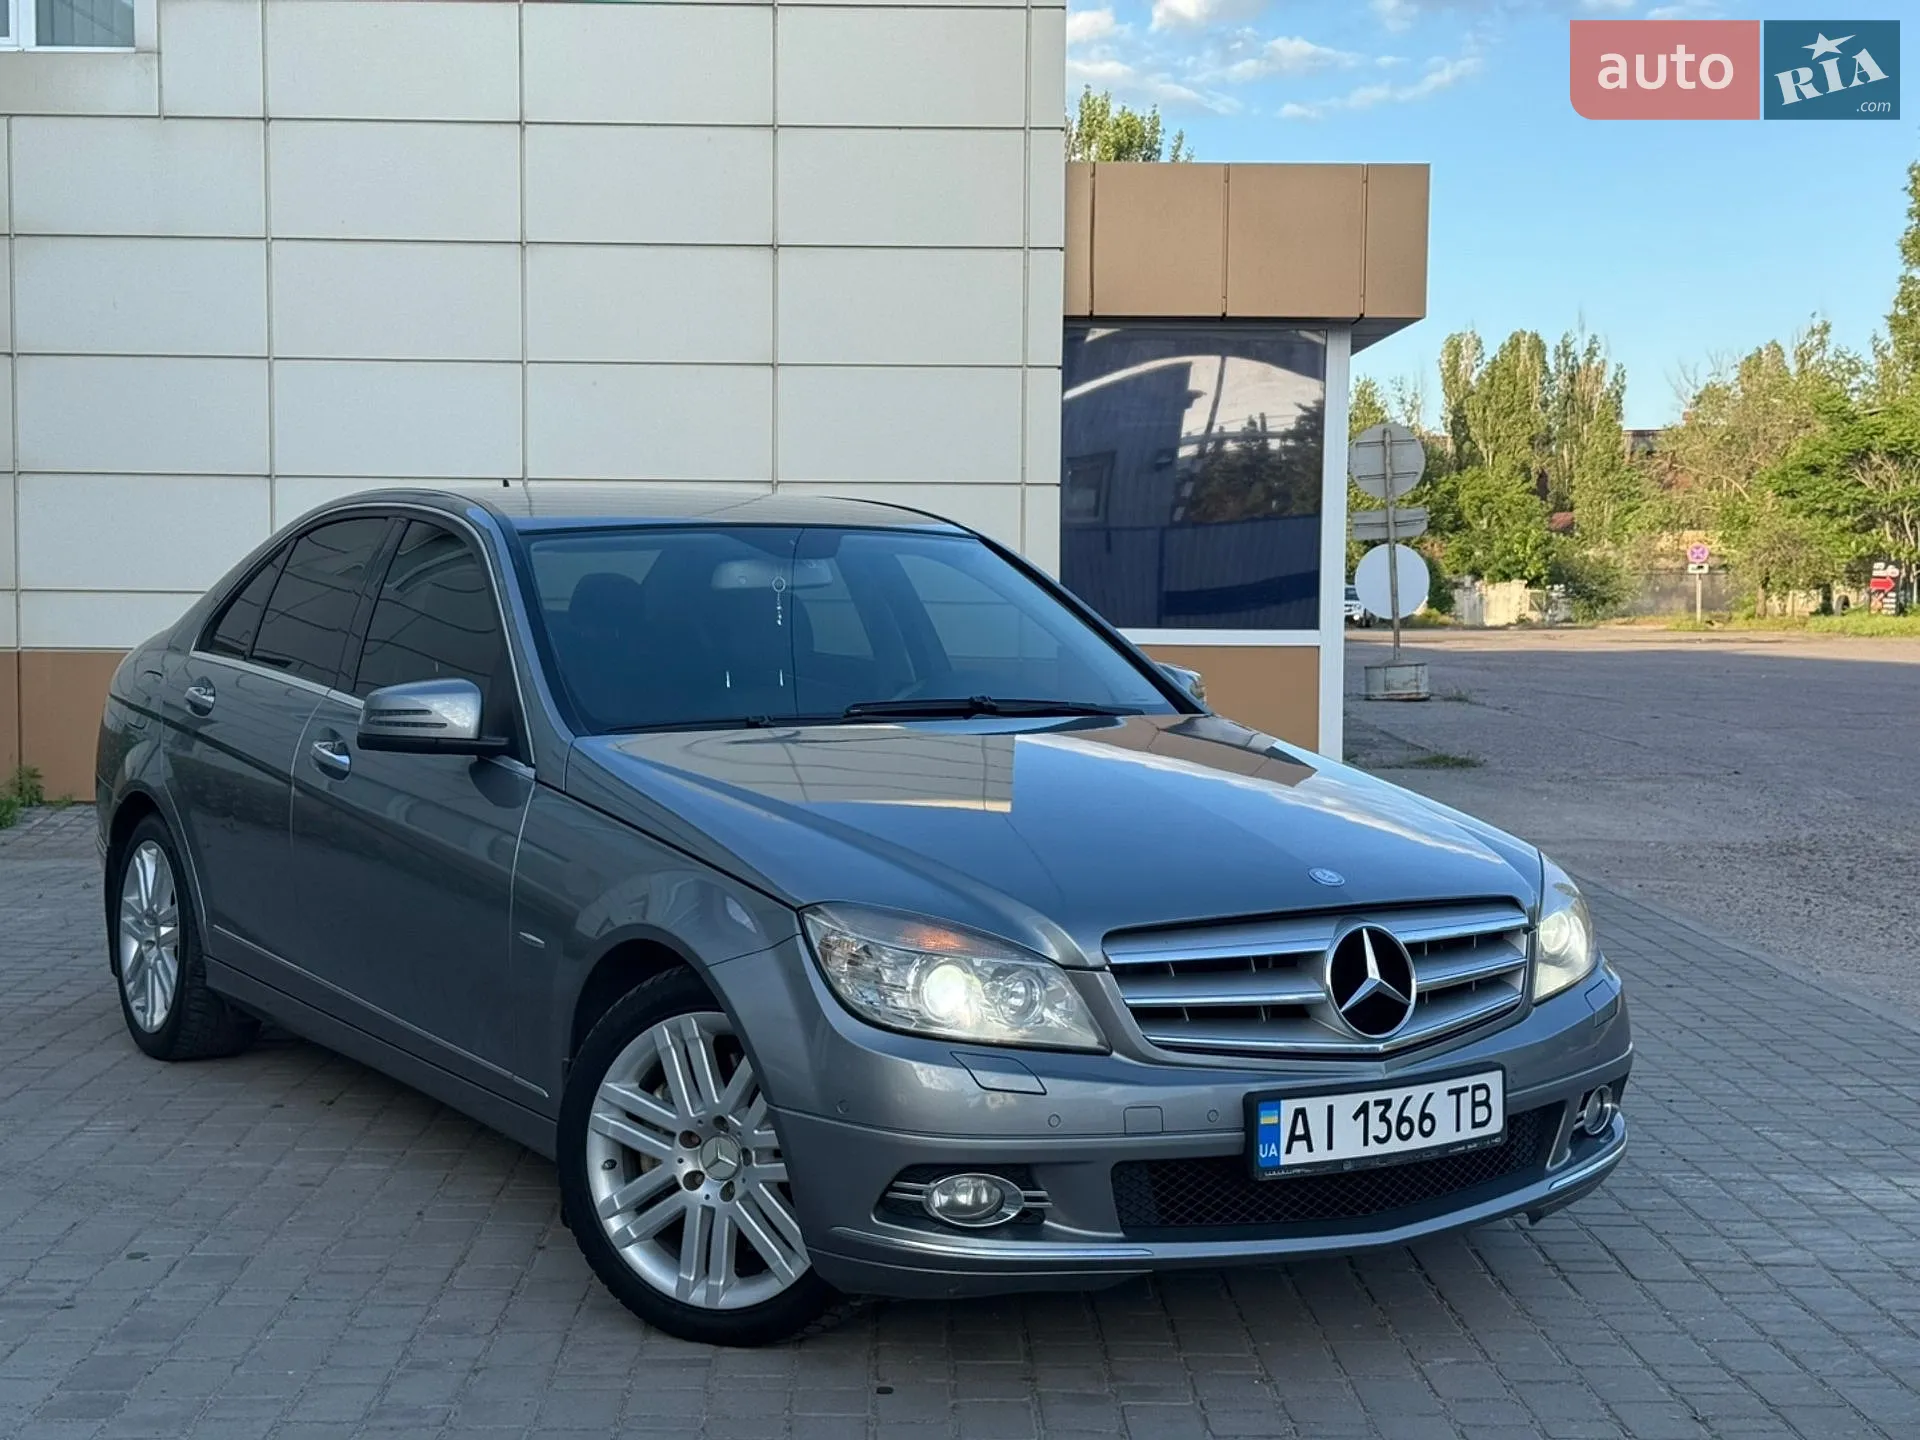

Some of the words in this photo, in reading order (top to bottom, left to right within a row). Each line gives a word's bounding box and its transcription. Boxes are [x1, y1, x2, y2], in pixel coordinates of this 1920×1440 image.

[1285, 1104, 1334, 1155] AI
[1352, 1092, 1436, 1147] 1366
[1447, 1083, 1492, 1132] TB
[1259, 1143, 1278, 1158] UA
